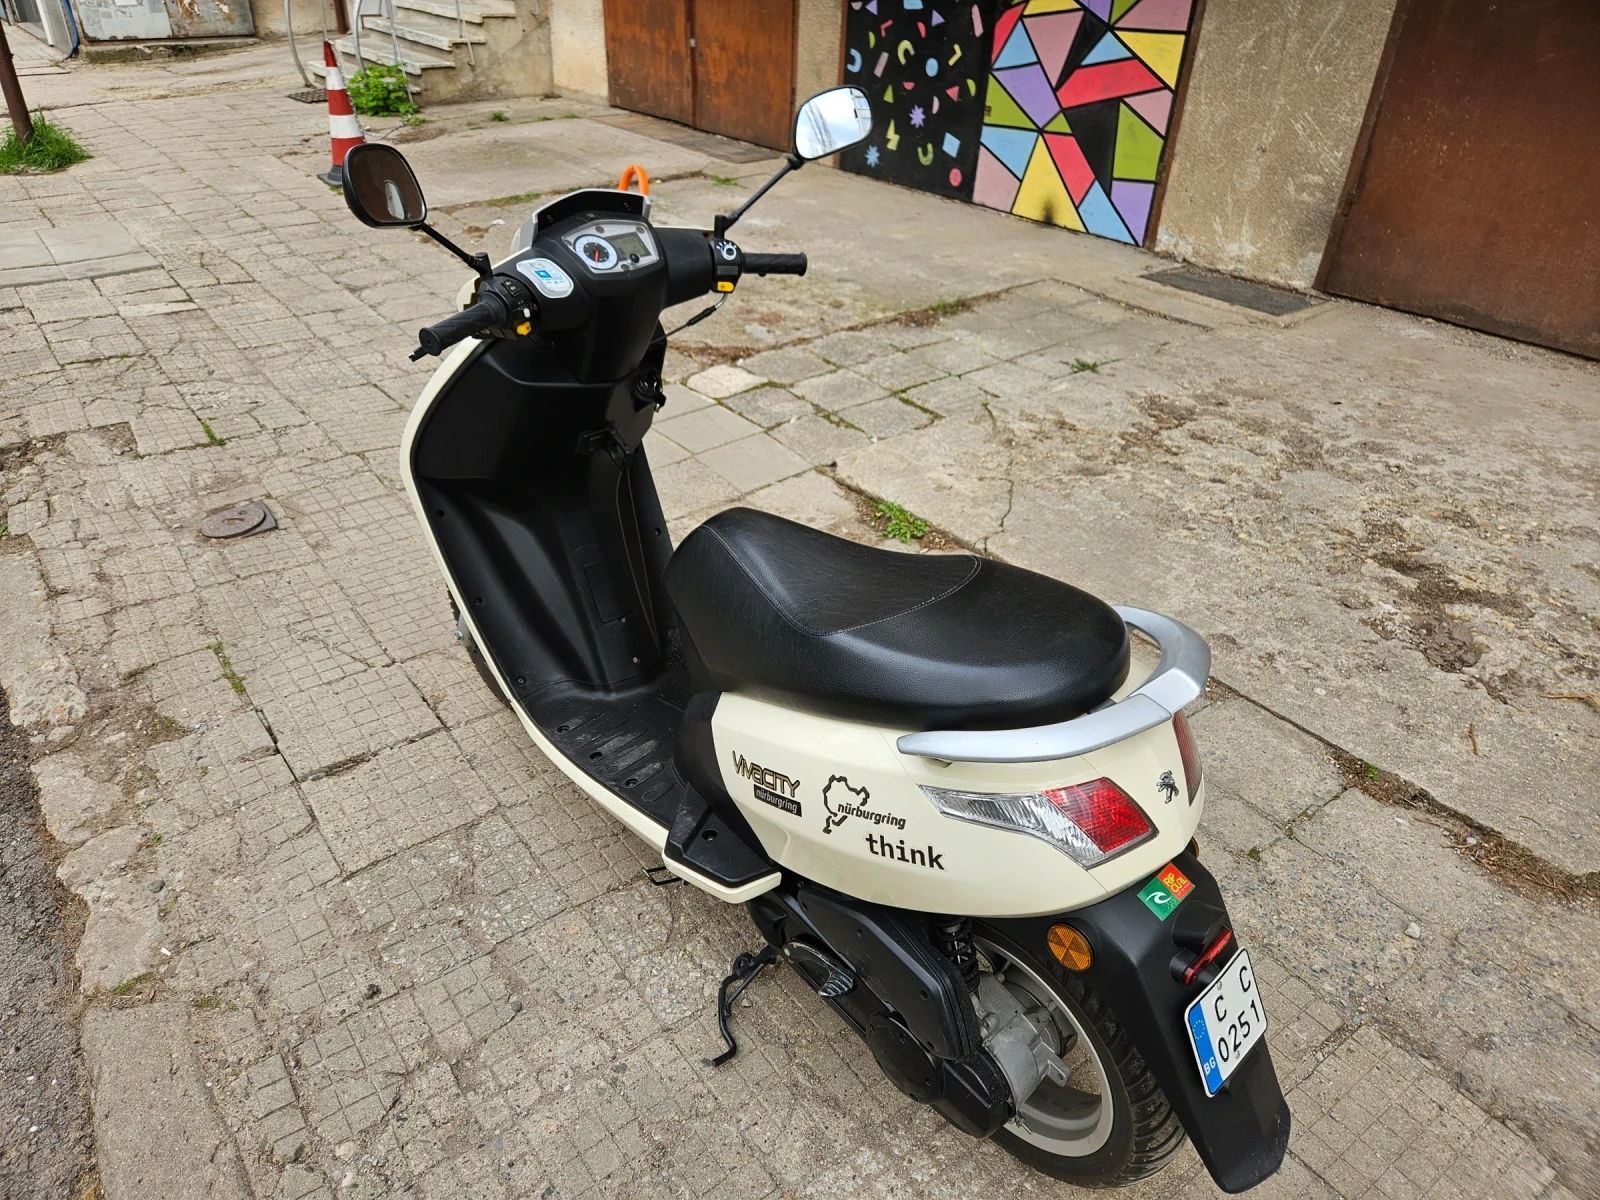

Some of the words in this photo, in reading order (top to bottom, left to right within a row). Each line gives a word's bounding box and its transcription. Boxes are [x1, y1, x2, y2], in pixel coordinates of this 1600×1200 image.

[756, 789, 798, 814] nürburgring
[837, 802, 906, 829] nürburgring
[865, 833, 945, 871] think
[1163, 873, 1175, 887] RIP
[1214, 995, 1227, 1022] C
[1239, 965, 1251, 993] C
[1218, 999, 1260, 1063] 0251
[1203, 1056, 1216, 1076] BG
